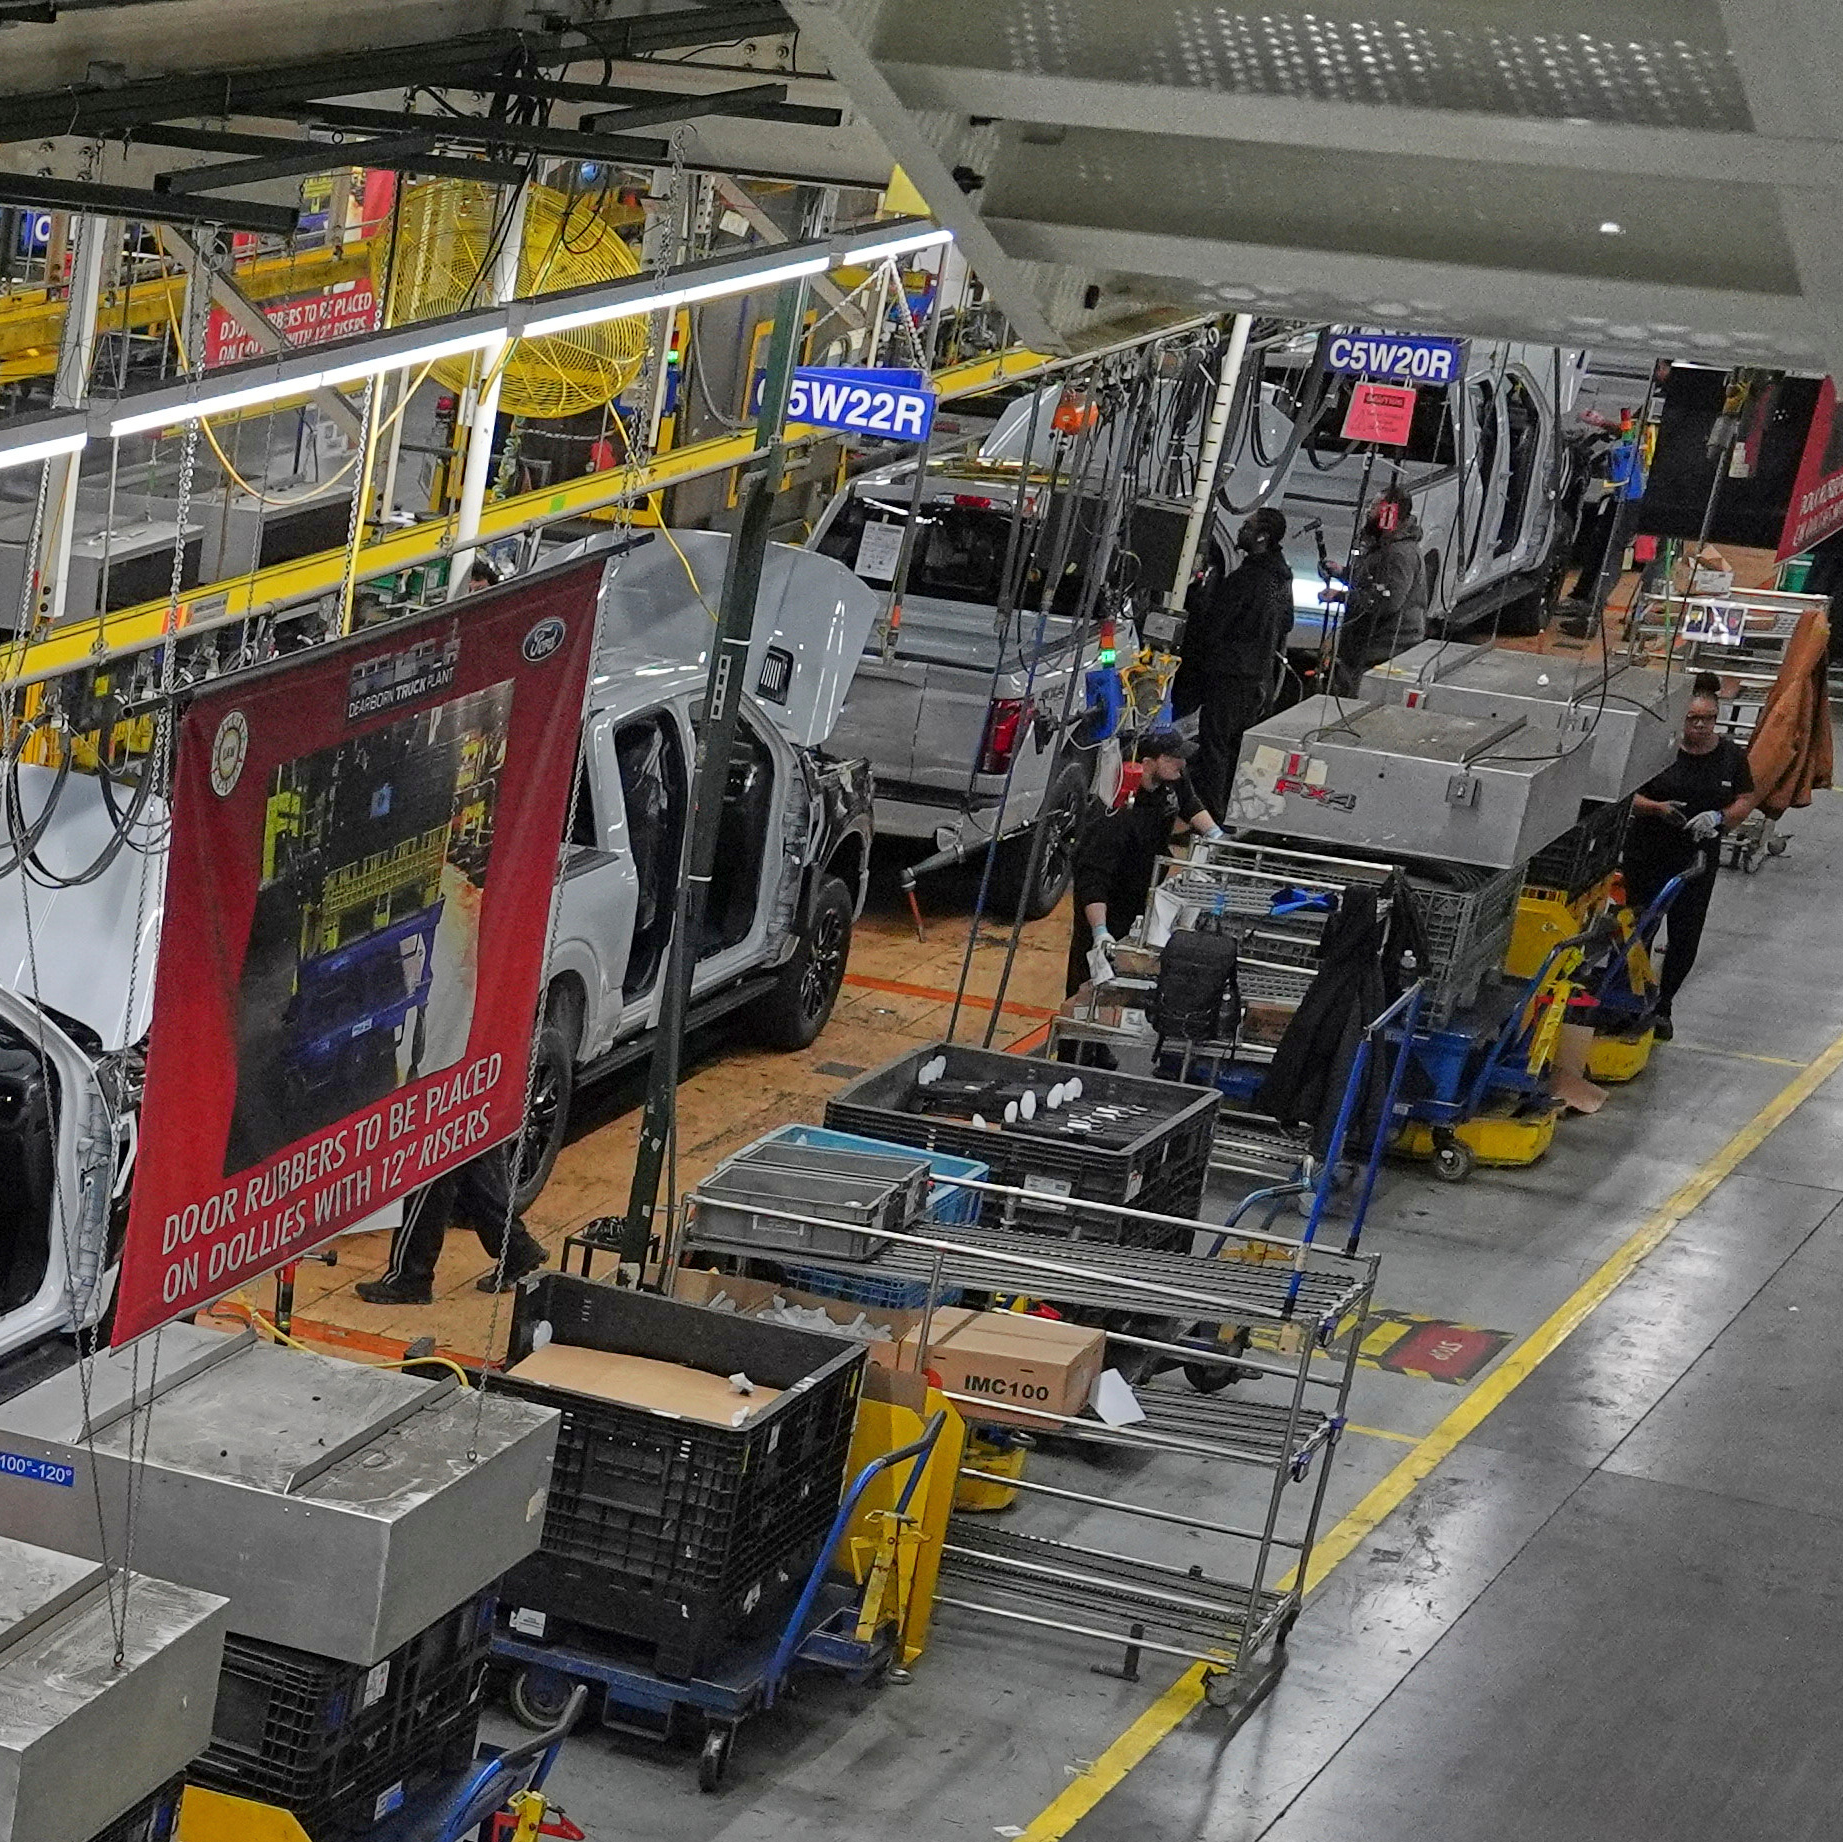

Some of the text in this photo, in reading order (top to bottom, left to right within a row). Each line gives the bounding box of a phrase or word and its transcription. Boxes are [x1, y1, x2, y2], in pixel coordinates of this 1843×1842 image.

[304, 303, 317, 323] TO
[334, 291, 373, 318] PLACED
[1329, 338, 1452, 379] C5W20R
[348, 666, 455, 719] DEARBORN TRUCK PLANT
[161, 1051, 503, 1256] DOOR RUBBERS TO BE PLACED
[162, 1251, 200, 1304] ON
[208, 1198, 308, 1283] DOLLIES
[314, 1170, 372, 1228] WITH
[417, 1100, 493, 1172] RISERS
[964, 1374, 1050, 1401] IMC100
